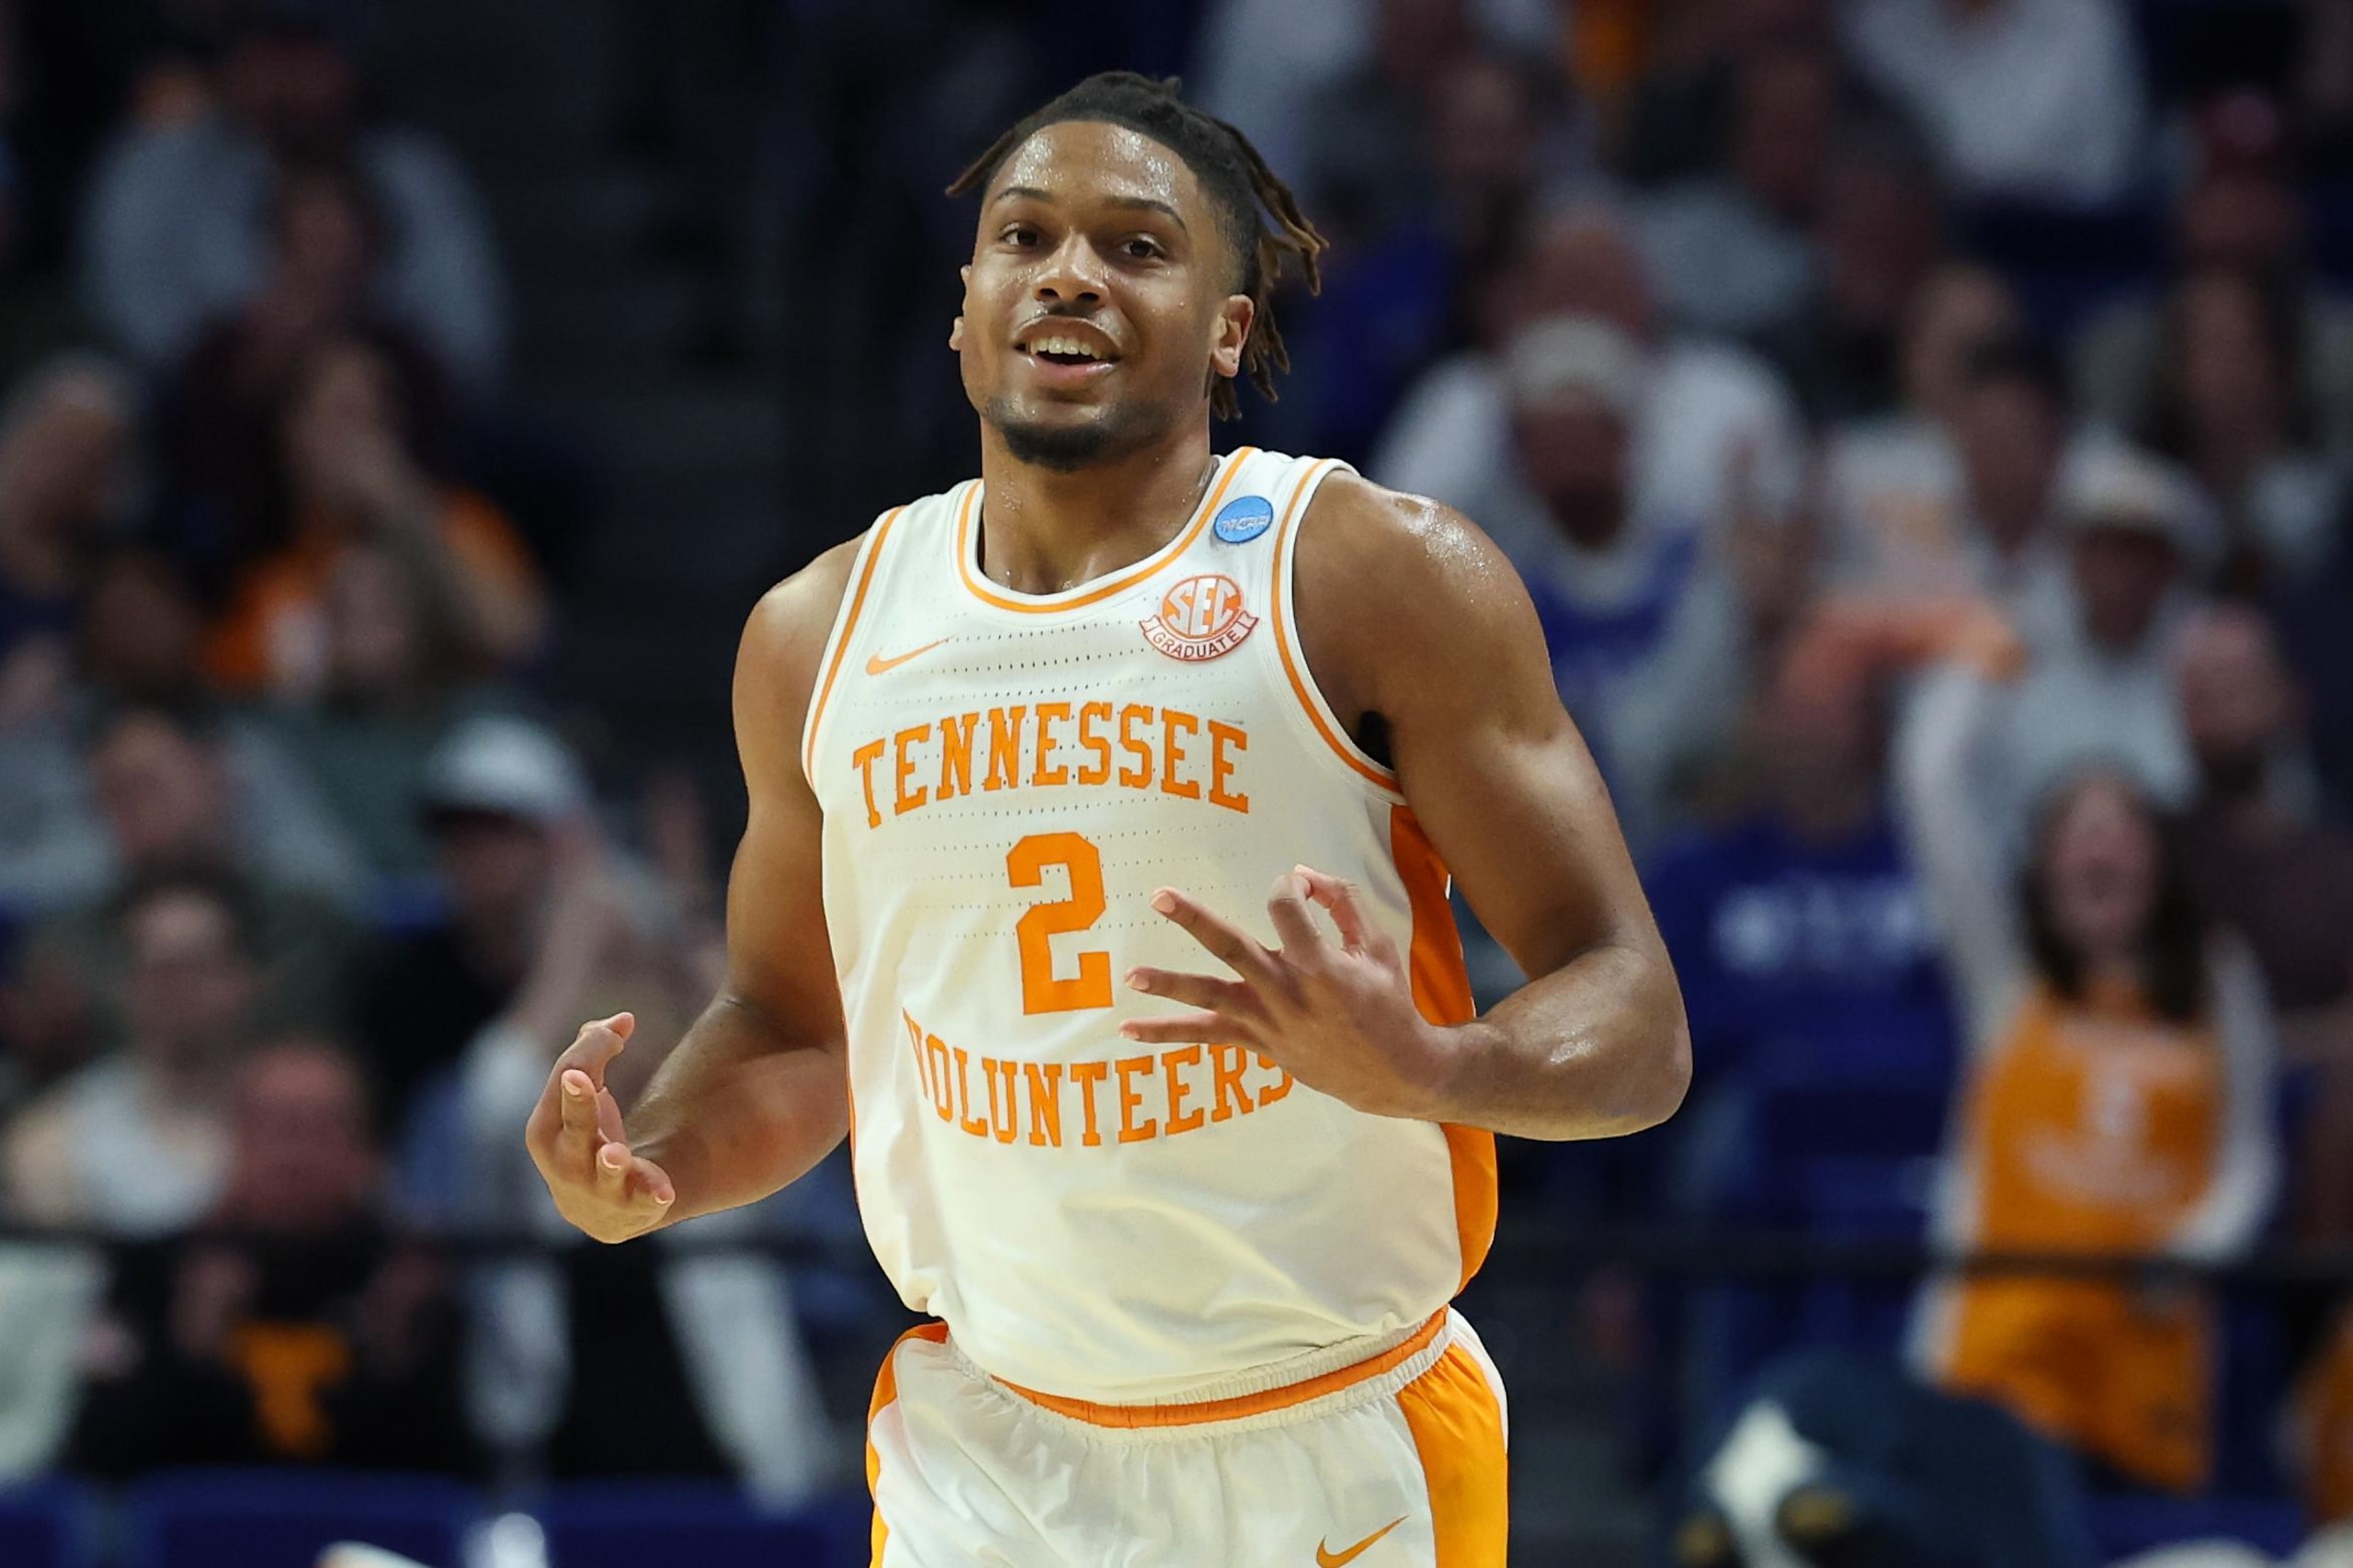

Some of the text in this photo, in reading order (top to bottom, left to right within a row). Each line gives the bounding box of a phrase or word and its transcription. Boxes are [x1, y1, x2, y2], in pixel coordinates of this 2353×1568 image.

[1152, 629, 1241, 659] GRADUATE
[1165, 576, 1240, 636] SEC
[852, 701, 1250, 829] TENNESSEE
[1006, 831, 1114, 1016] 2
